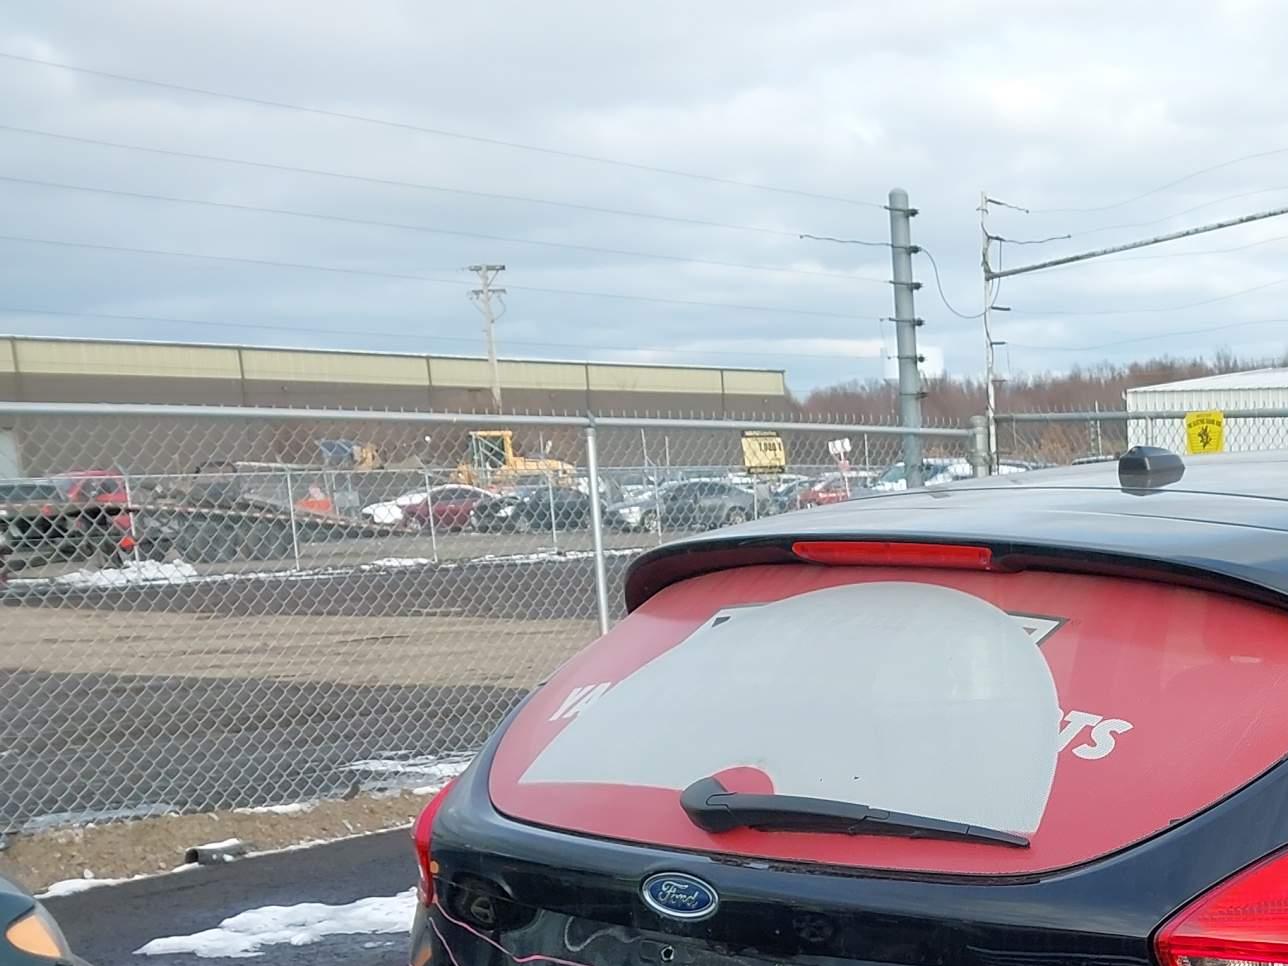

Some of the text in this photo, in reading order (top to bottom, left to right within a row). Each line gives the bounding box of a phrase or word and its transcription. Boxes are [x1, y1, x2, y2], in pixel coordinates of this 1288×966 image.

[549, 682, 612, 721] YA
[1058, 708, 1134, 760] TS
[658, 881, 699, 908] Ford
